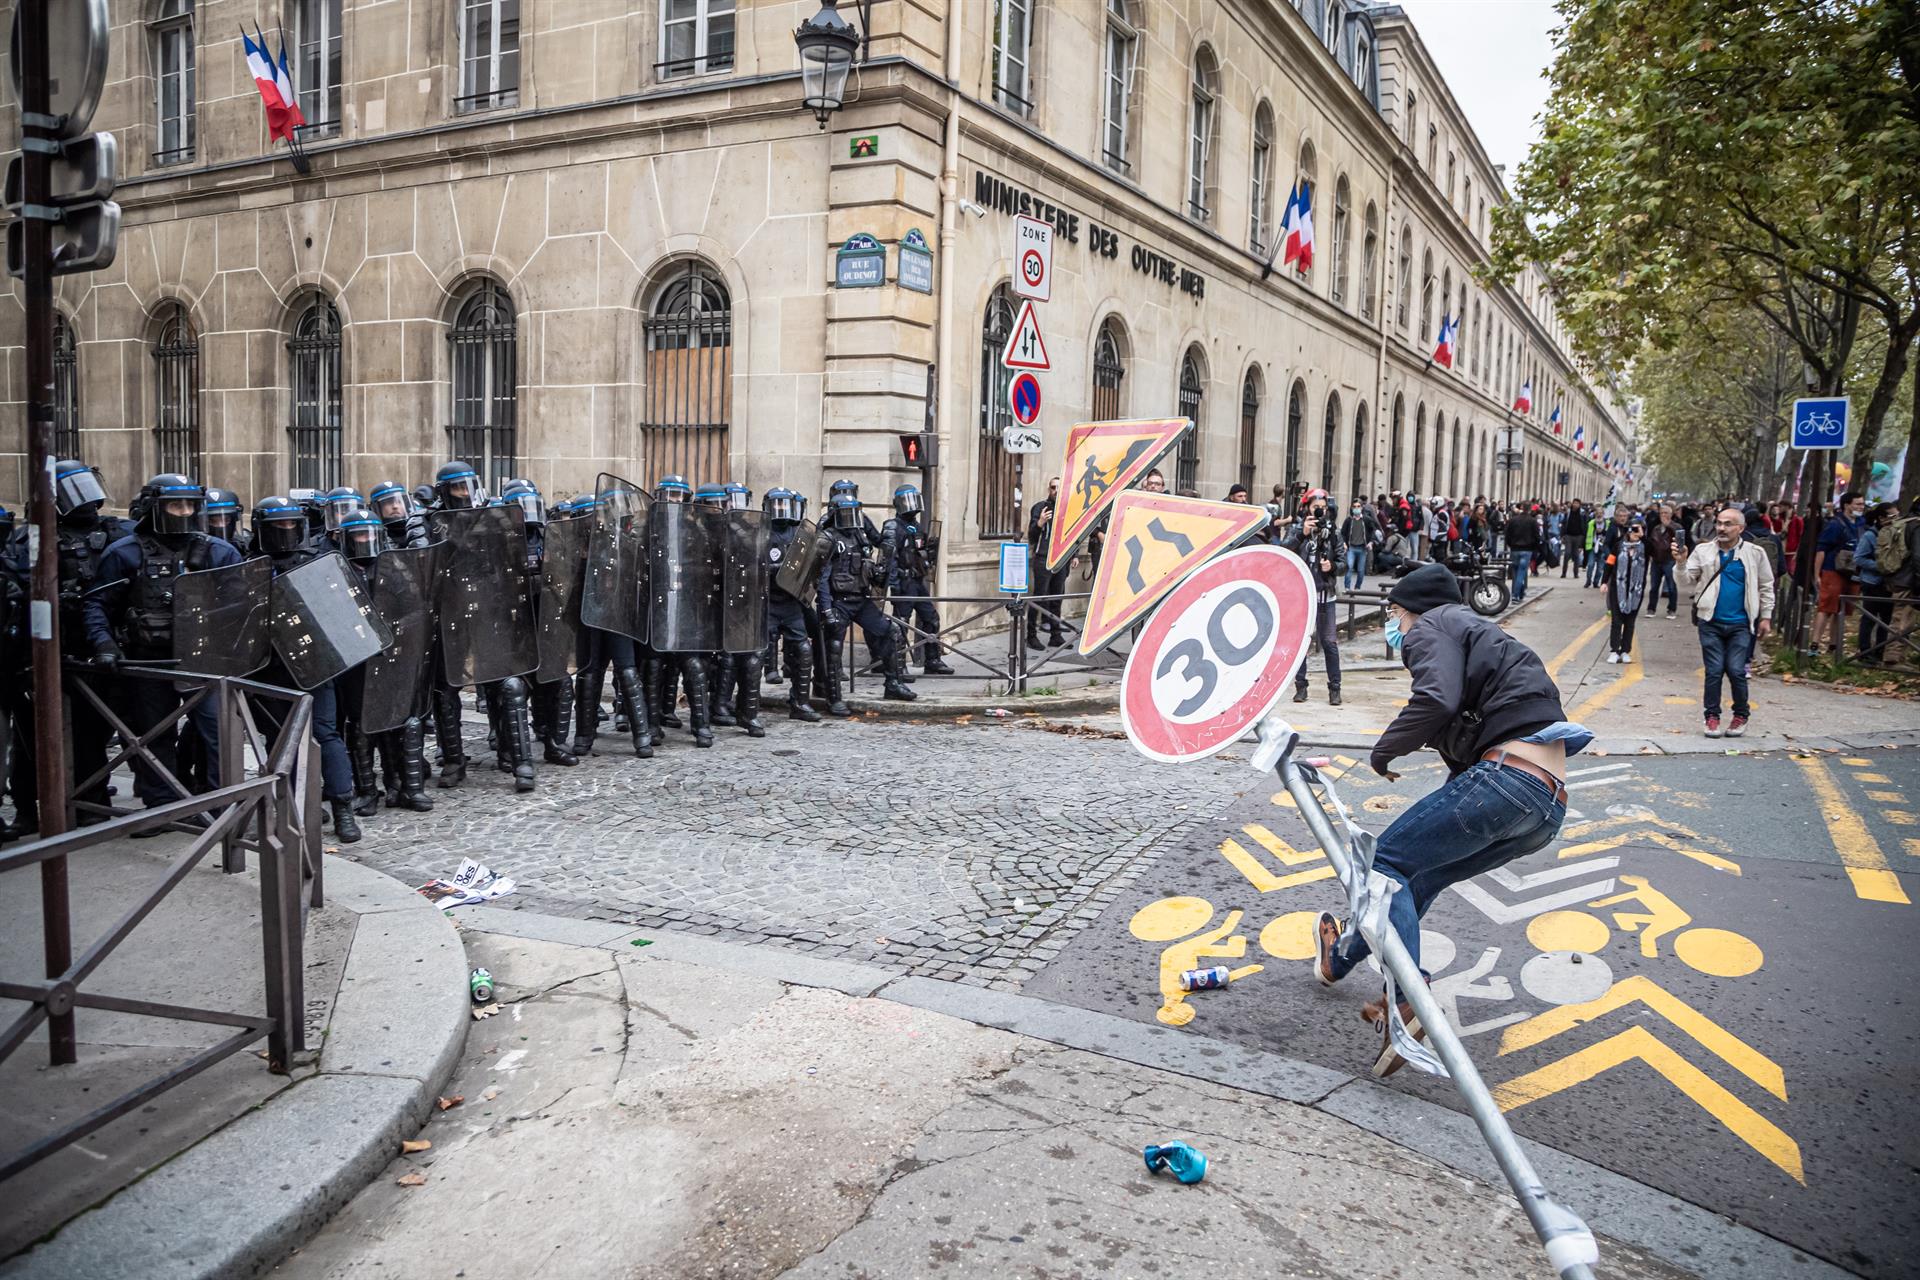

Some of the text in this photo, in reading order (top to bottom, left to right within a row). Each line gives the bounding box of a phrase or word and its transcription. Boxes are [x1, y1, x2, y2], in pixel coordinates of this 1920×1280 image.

[976, 171, 1205, 299] MINISTERE DES OUTRE-MER
[1023, 226, 1046, 242] ZONE
[852, 260, 870, 269] RUE
[1026, 259, 1040, 277] 30
[843, 271, 877, 280] OUDINOT
[1156, 586, 1274, 718] 30
